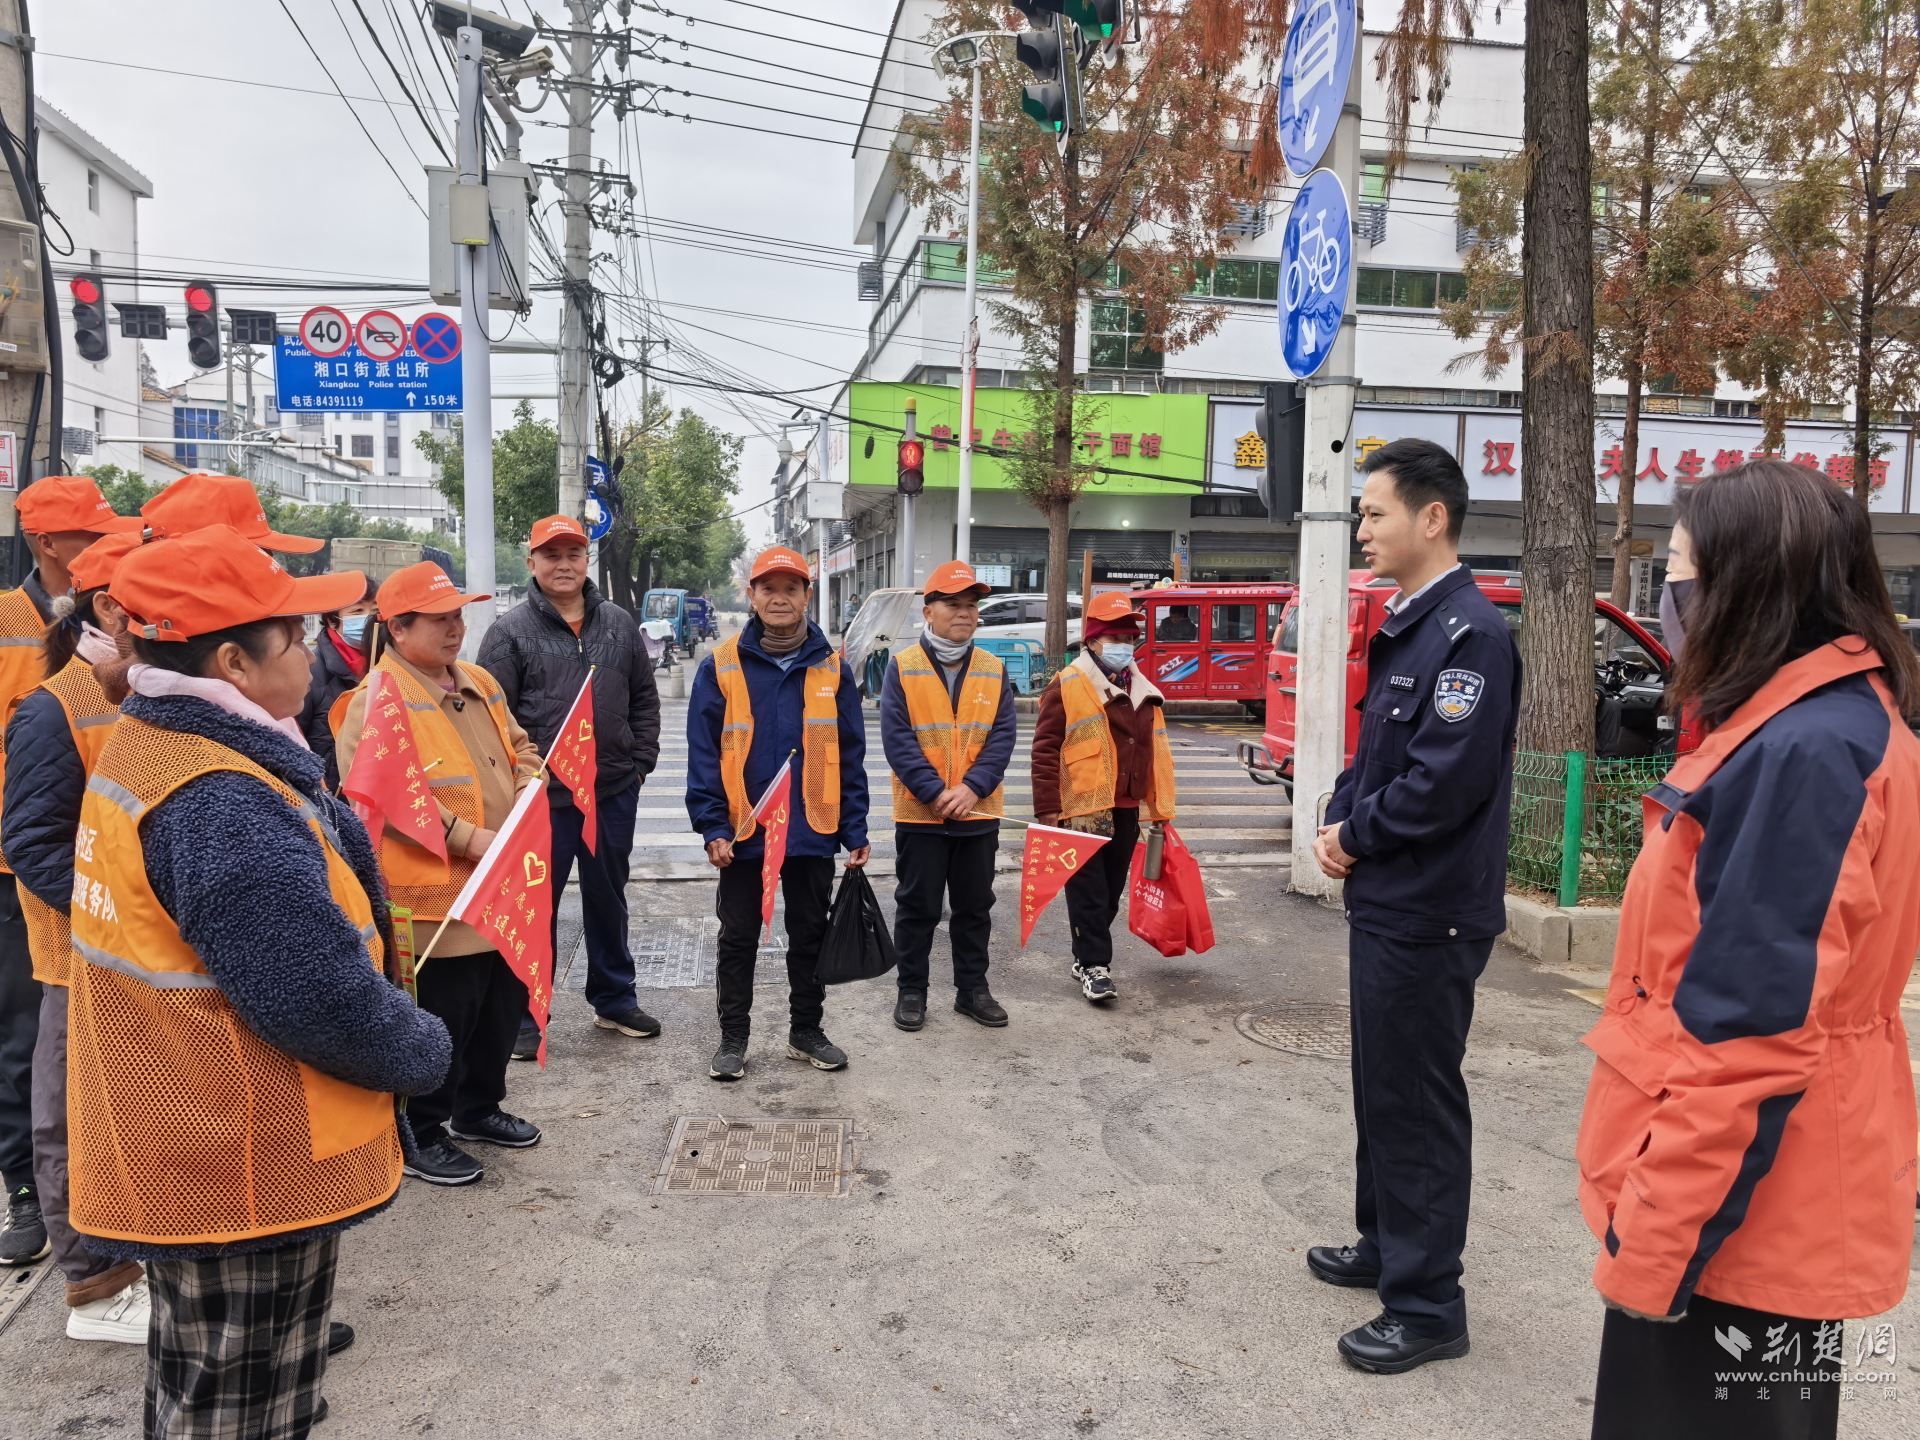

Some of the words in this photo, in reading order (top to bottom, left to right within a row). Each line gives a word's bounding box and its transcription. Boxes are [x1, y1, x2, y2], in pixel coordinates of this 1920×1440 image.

[310, 320, 342, 343] 40
[285, 349, 311, 357] Public
[314, 361, 429, 378] 湘口街派出所
[319, 381, 359, 389] Xiangkou
[291, 395, 364, 407] 电话:84391119
[424, 394, 457, 406] 150米
[1157, 655, 1184, 676] 大江
[1390, 675, 1414, 687] 037322
[1441, 681, 1450, 691] 警
[1464, 685, 1475, 695] 察
